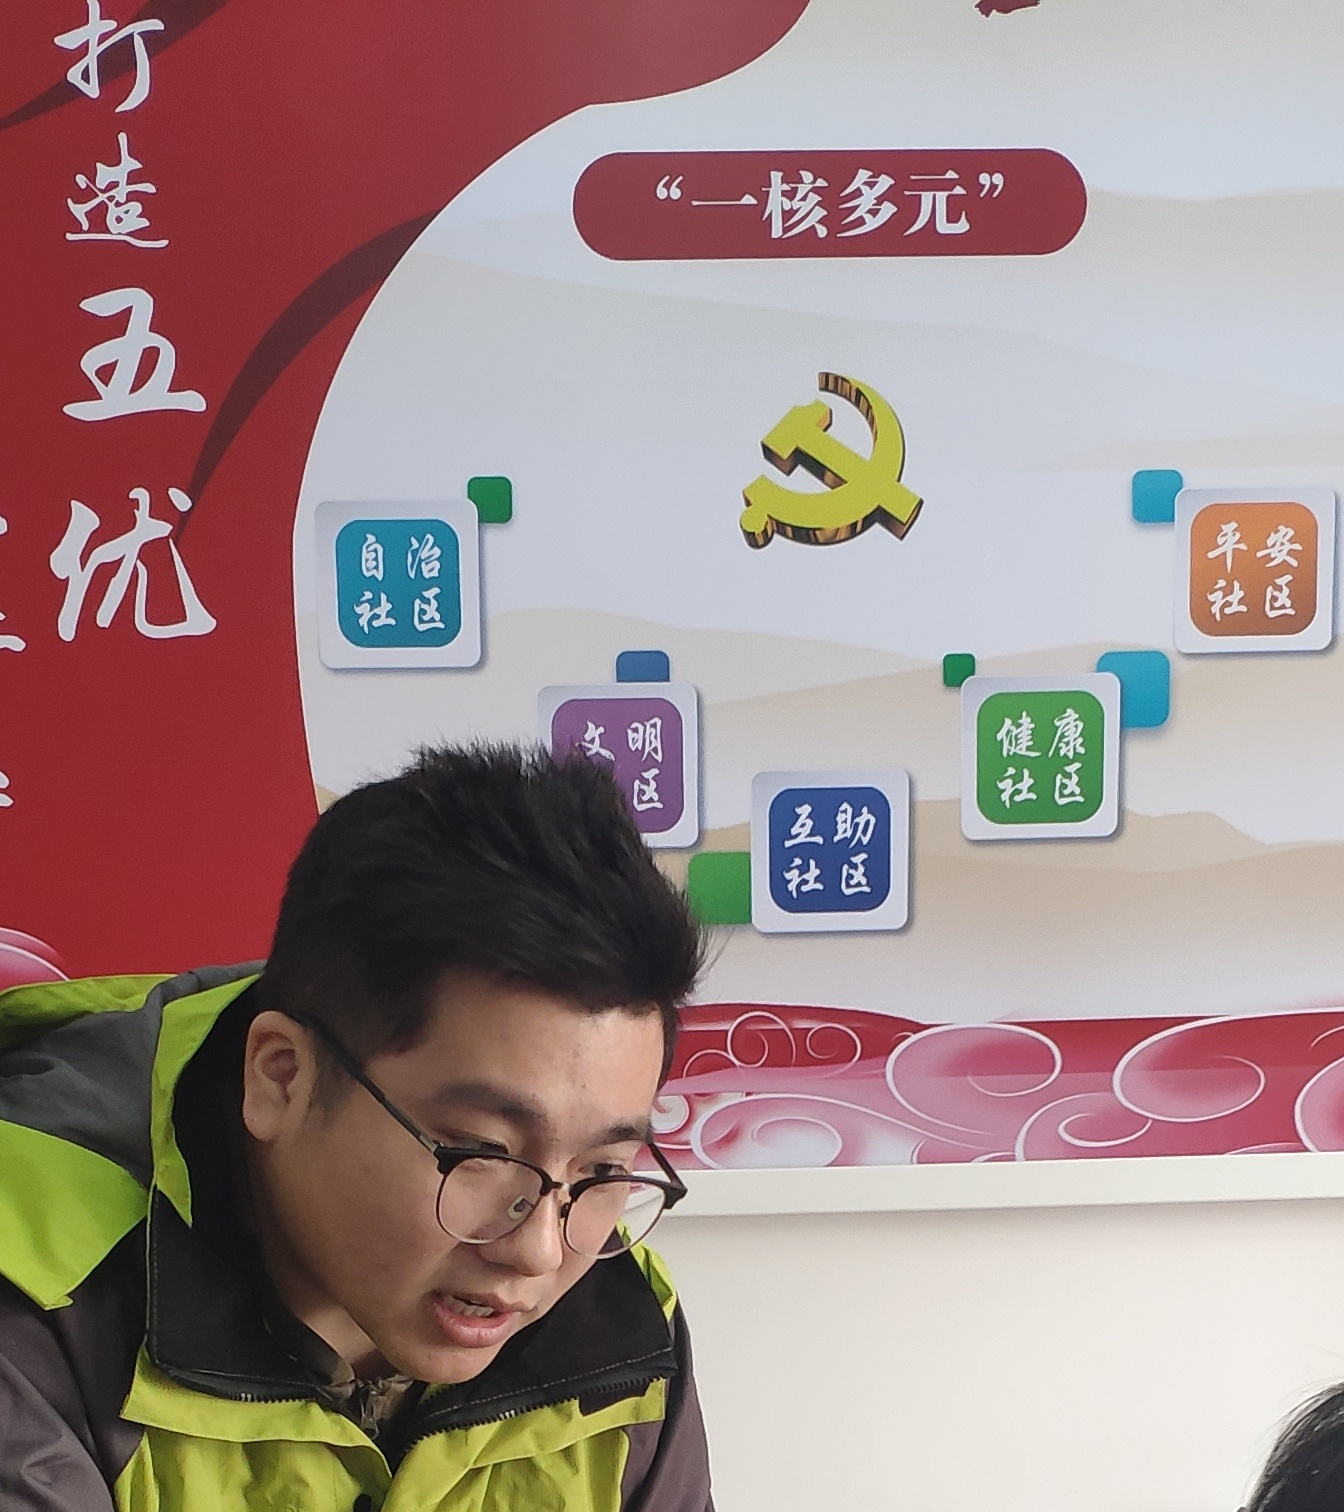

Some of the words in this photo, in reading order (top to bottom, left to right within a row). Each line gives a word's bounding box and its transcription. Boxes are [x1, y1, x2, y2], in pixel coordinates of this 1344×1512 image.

[49, 0, 217, 641] 打造五优
[359, 535, 441, 581] 自治
[1208, 523, 1303, 573] 平安
[355, 589, 445, 634] 社区
[1208, 576, 1296, 622] 社区
[583, 719, 663, 763] 文明
[998, 710, 1086, 760] 健康
[634, 769, 664, 812] 区
[998, 764, 1085, 809] 社区
[786, 804, 876, 848] 互助
[785, 854, 871, 899] 社区
